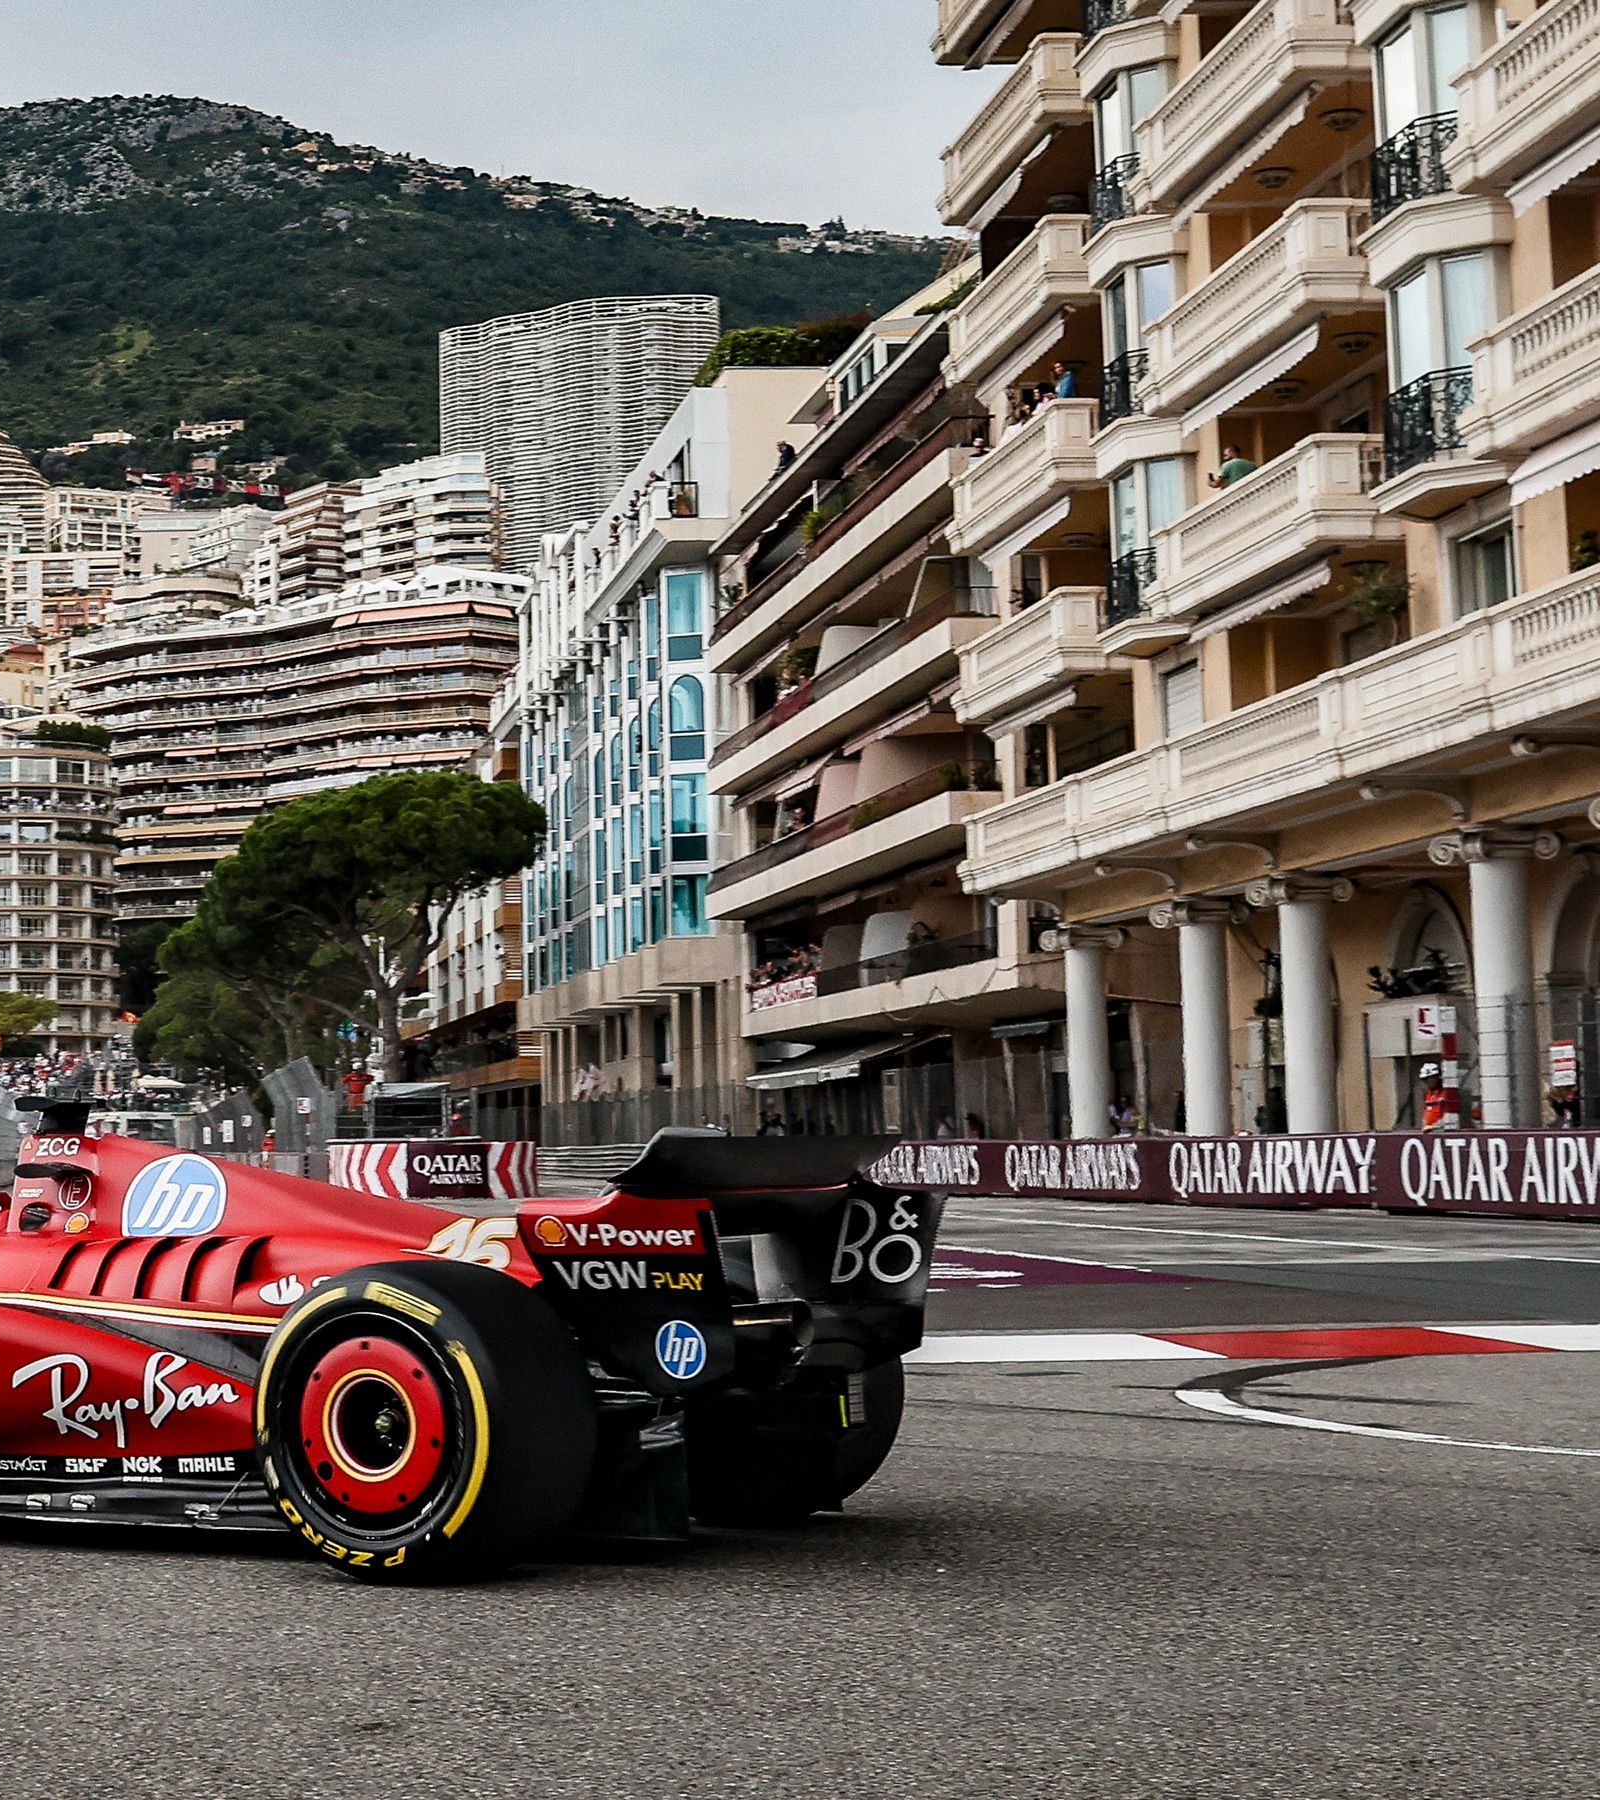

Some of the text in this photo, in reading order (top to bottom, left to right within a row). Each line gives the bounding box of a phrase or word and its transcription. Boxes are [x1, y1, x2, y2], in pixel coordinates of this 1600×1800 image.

[35, 1138, 81, 1156] ZCG
[412, 1154, 482, 1176] QATAR
[1004, 1143, 1141, 1191] QATAR AIRWAYS
[1168, 1138, 1376, 1198] QATAR AIRWAY
[1401, 1138, 1513, 1206] QATAR
[127, 1157, 219, 1236] hp
[418, 1217, 518, 1269] 16
[567, 1223, 696, 1246] V-Power
[552, 1261, 703, 1290] VGW PLAY
[660, 1321, 700, 1378] hp
[65, 1458, 107, 1473] SKF
[122, 1456, 163, 1473] NGK
[178, 1457, 235, 1472] MAHLE
[280, 1498, 375, 1567] ZERO
